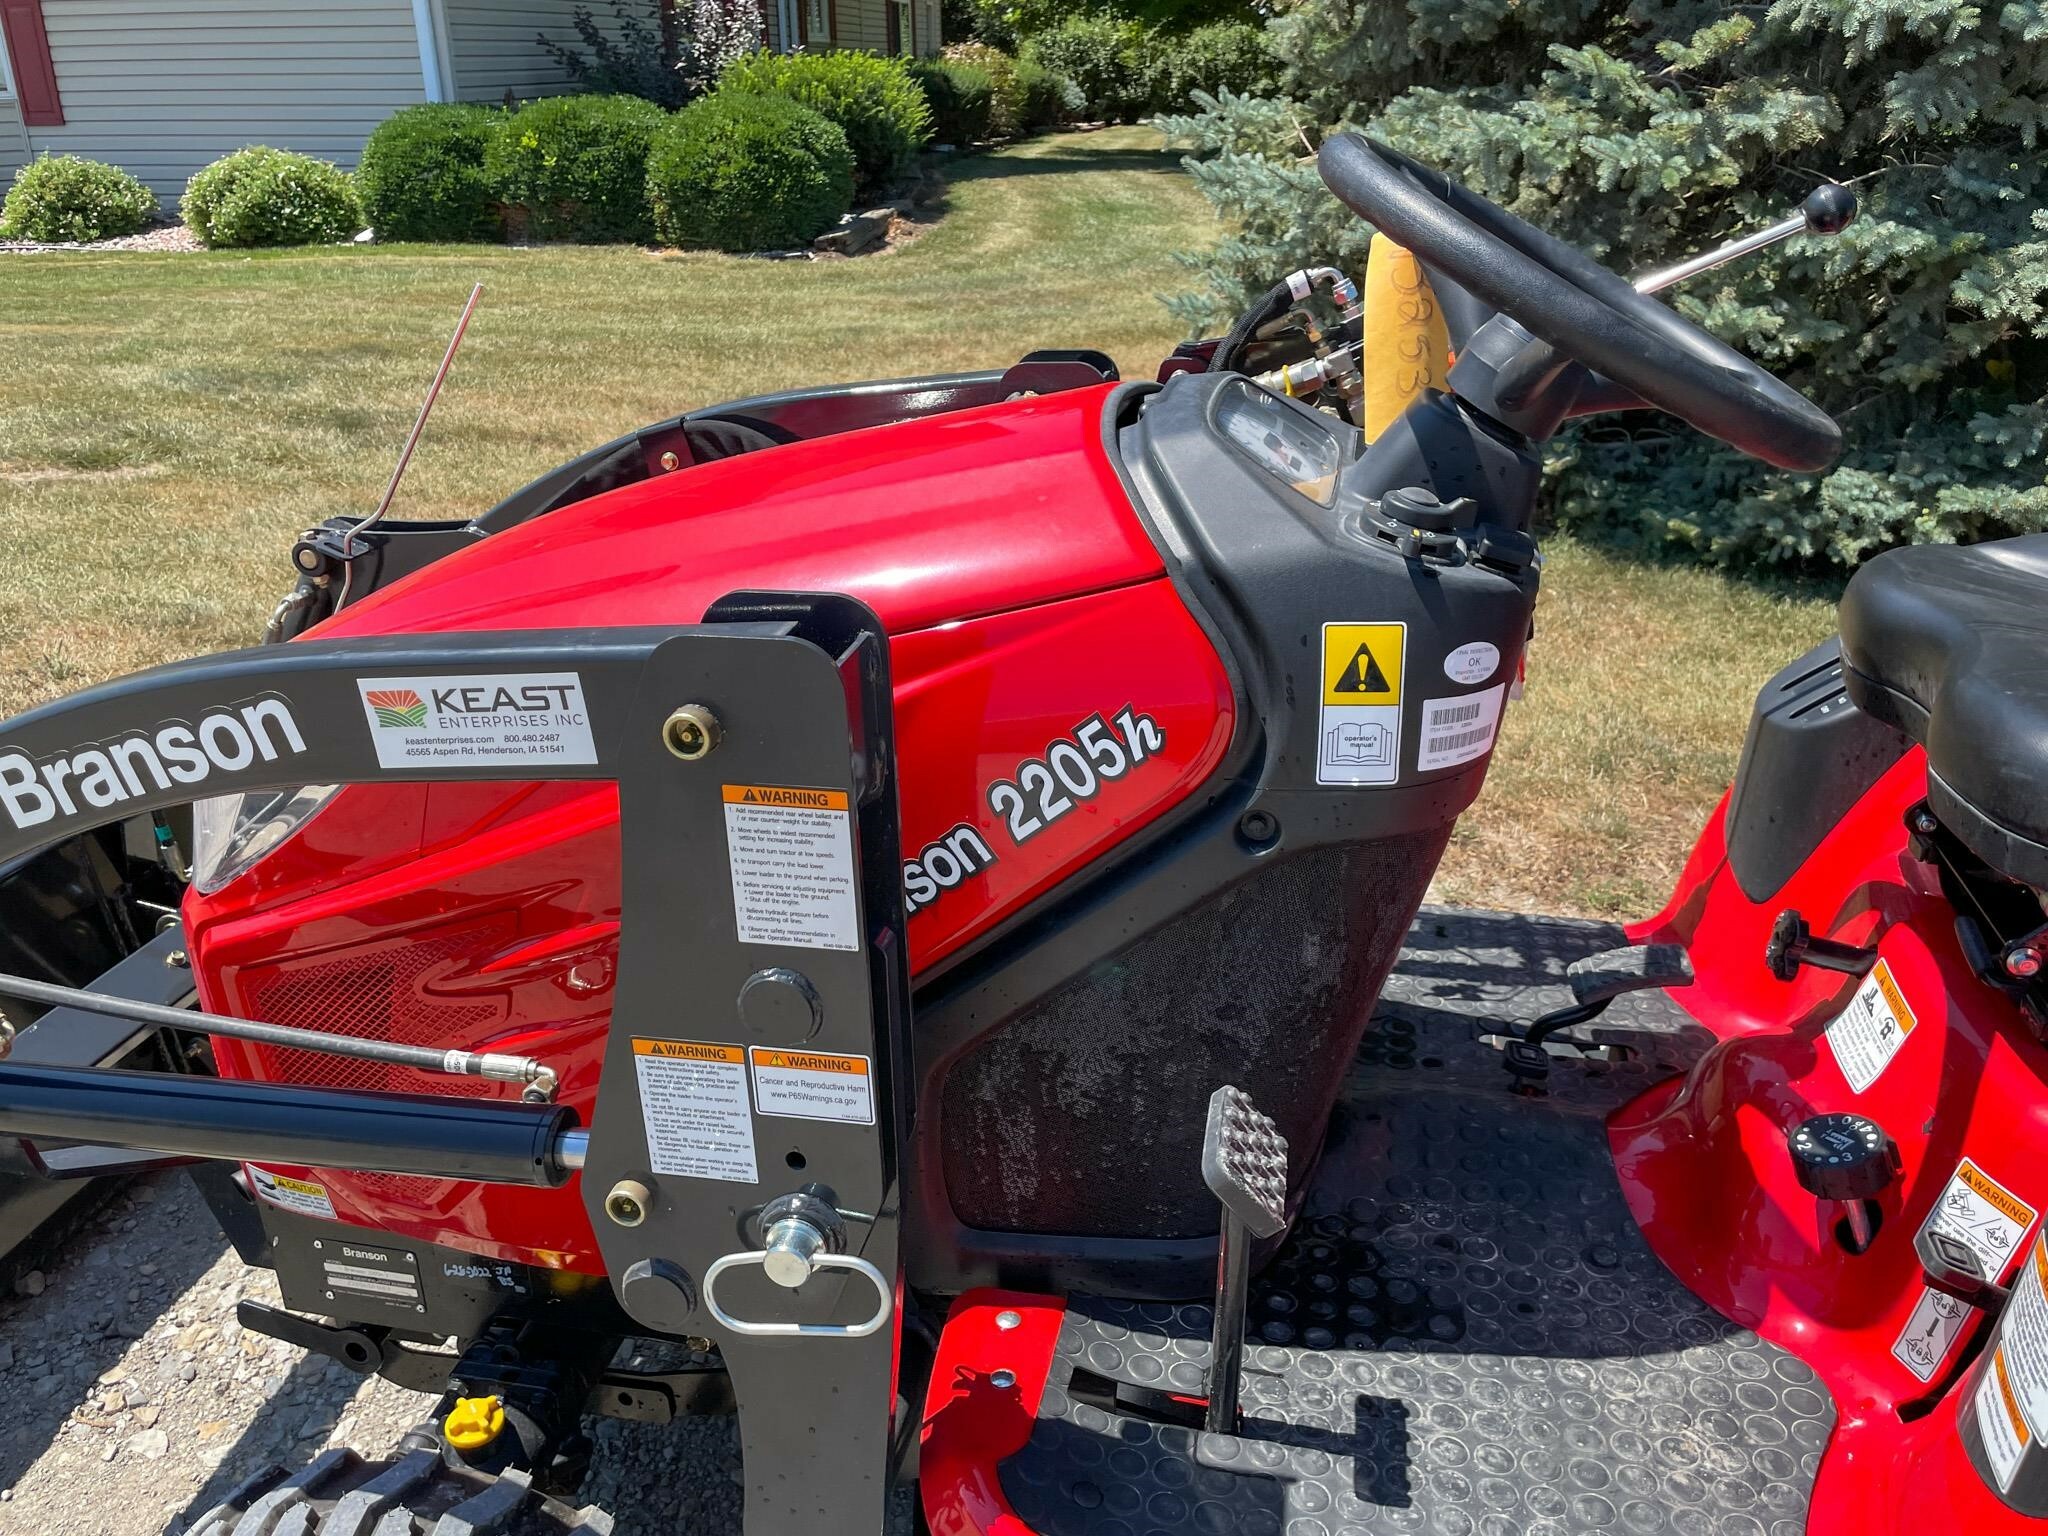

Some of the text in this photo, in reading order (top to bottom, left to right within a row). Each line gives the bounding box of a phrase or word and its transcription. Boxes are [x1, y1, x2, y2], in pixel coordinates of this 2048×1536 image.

[1468, 657, 1480, 666] OK
[431, 685, 575, 714] KEAST
[439, 714, 583, 729] ENTERPRISES INC
[406, 734, 560, 746] keastenterprises.com 800.480.2487
[1344, 735, 1377, 743] operator's
[406, 745, 565, 756] 45565 Aspen Rd, Henderson, IA 51541
[0, 700, 307, 829] Branson
[991, 712, 1162, 842] 2205h
[758, 790, 828, 806] WARNING
[1886, 986, 1906, 1020] WARNING
[665, 1044, 726, 1059] WARNING
[787, 1056, 851, 1070] WARNING
[759, 1076, 783, 1085] Cancer
[800, 1079, 844, 1091] Reproductive
[847, 1084, 865, 1092] Harm
[771, 1092, 856, 1105] www.P65Warnings.ca.gov
[286, 1181, 322, 1194] CAUTION
[1974, 1179, 2028, 1223] WARNING
[1953, 1226, 1964, 1237] use
[1967, 1236, 1977, 1247] the
[343, 1247, 387, 1262] Branson
